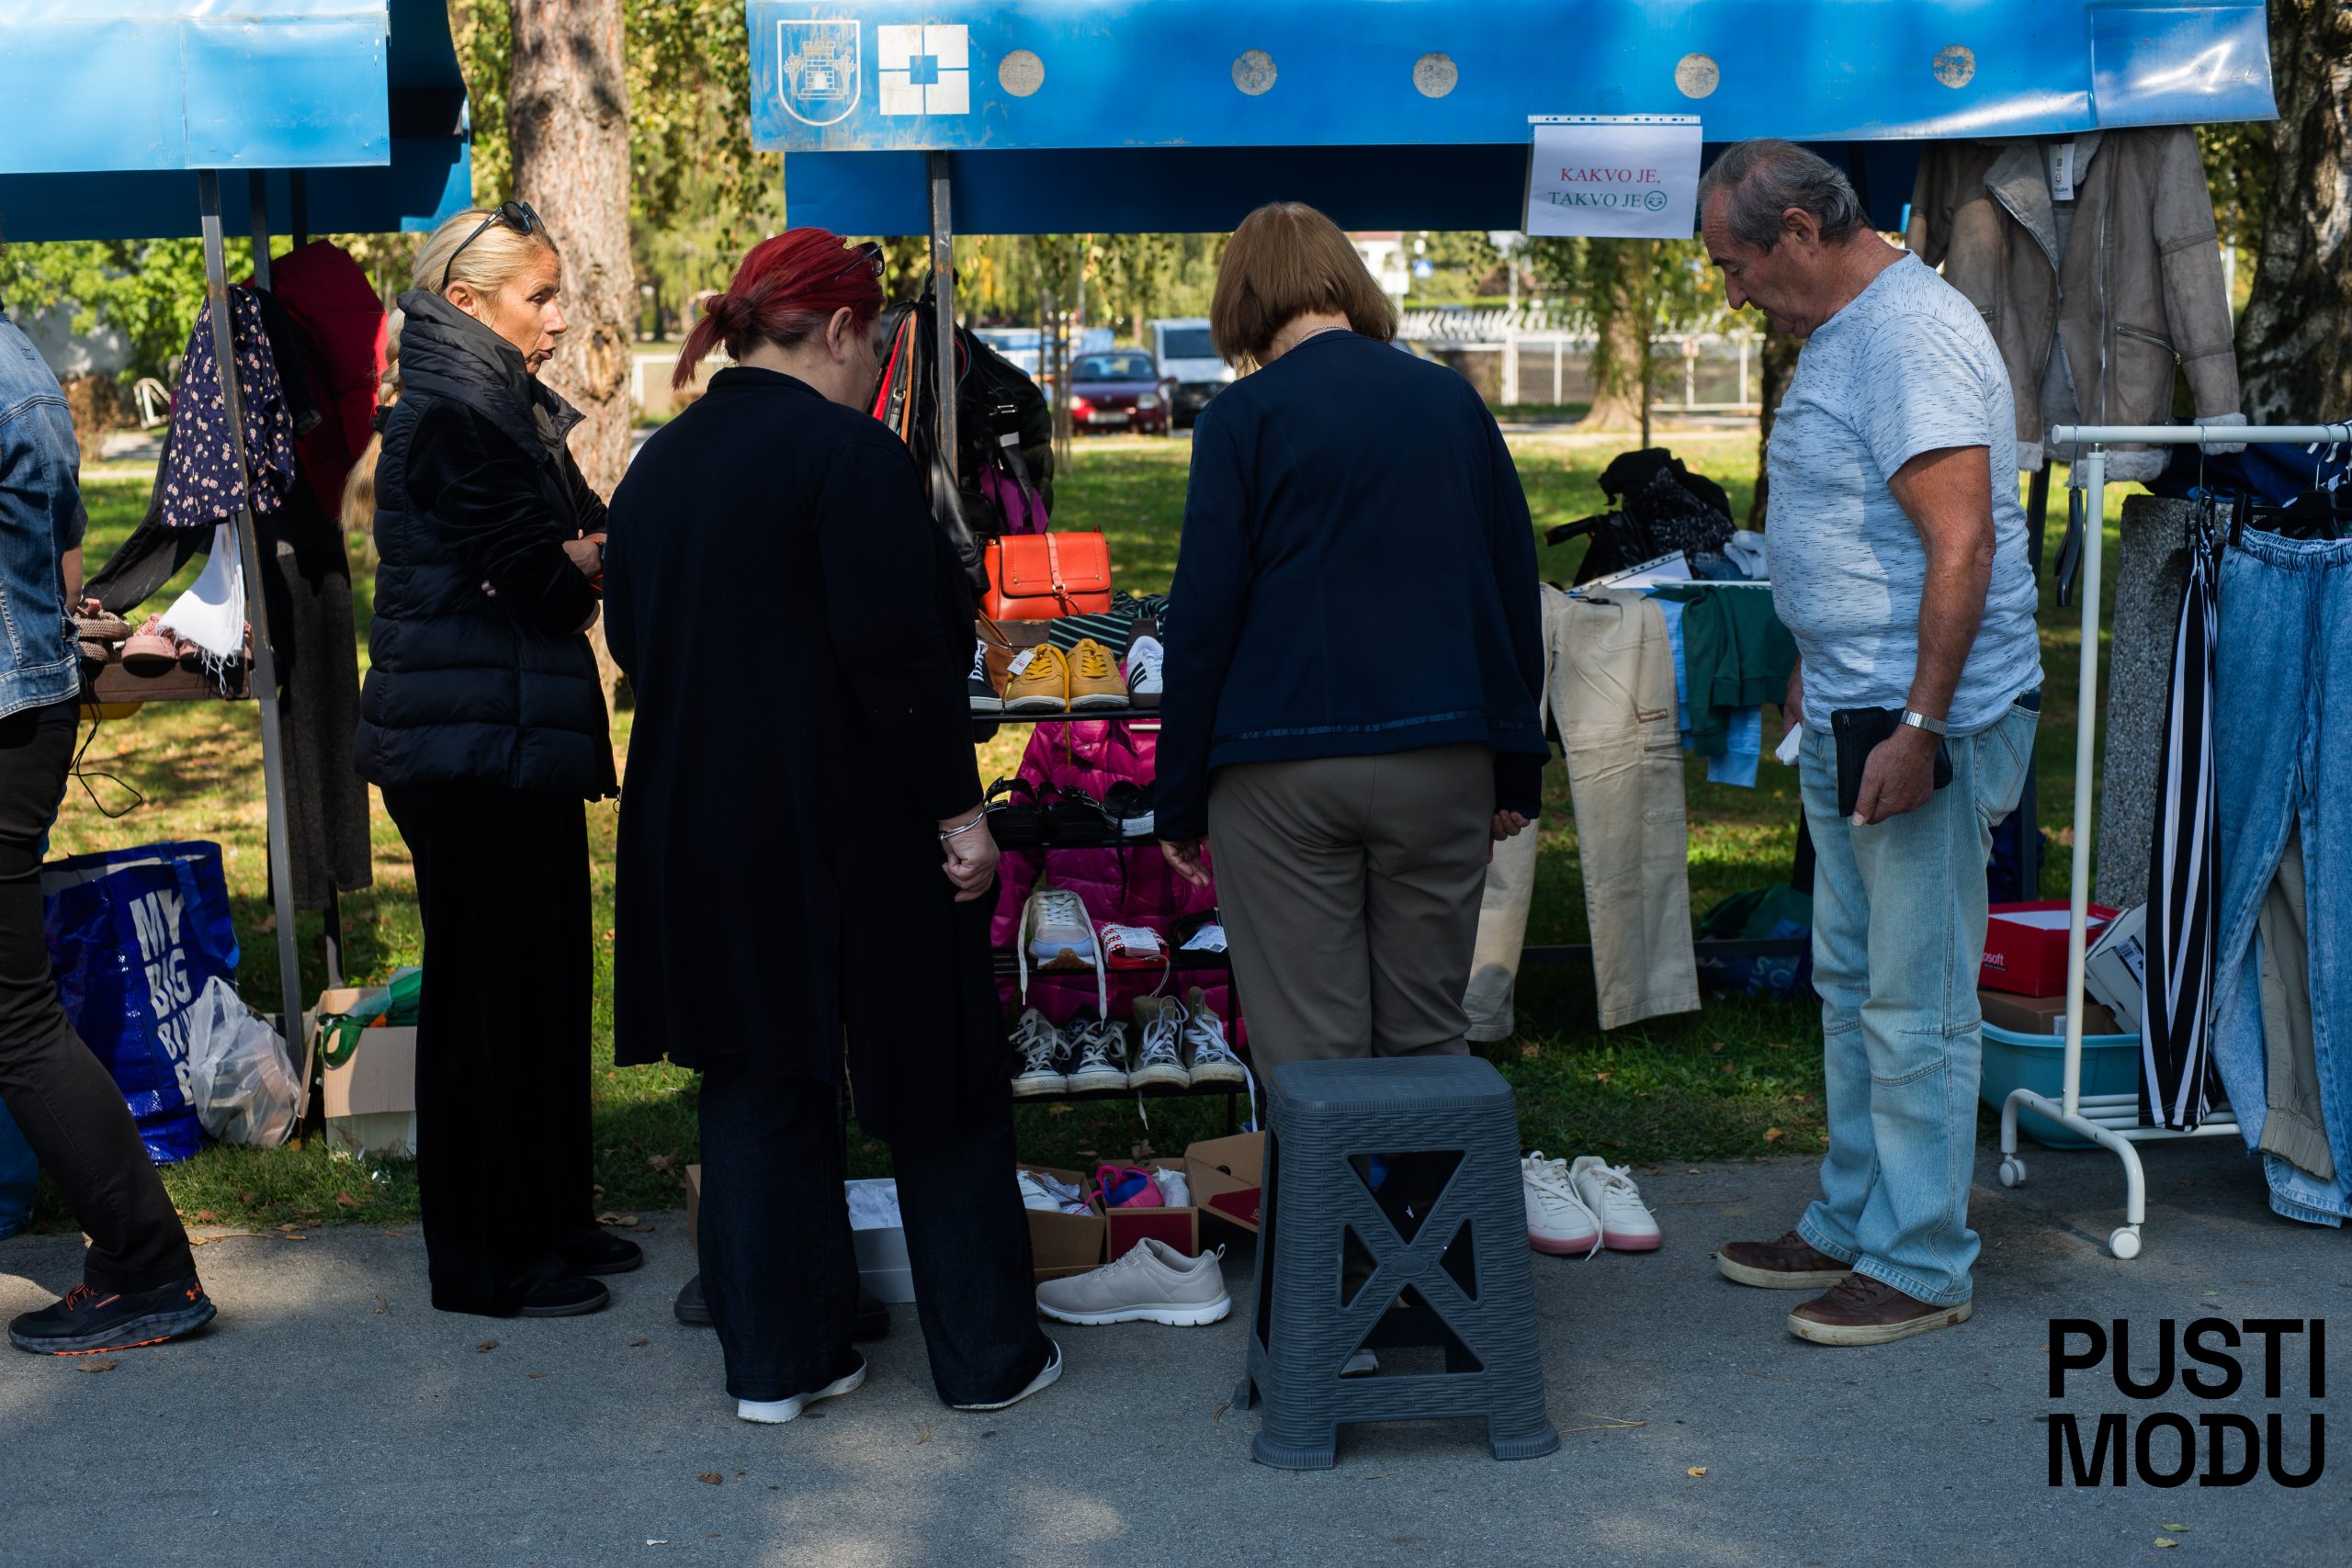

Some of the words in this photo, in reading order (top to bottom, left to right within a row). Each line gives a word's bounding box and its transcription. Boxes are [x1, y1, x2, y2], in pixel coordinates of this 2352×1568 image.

[1560, 168, 1632, 183] KAKVO
[1636, 169, 1661, 185] JE,
[1548, 191, 1617, 207] TAKVO
[1622, 194, 1643, 207] JE
[129, 889, 185, 962] MY
[1983, 953, 2004, 965] osoft
[144, 948, 192, 1020] BIG
